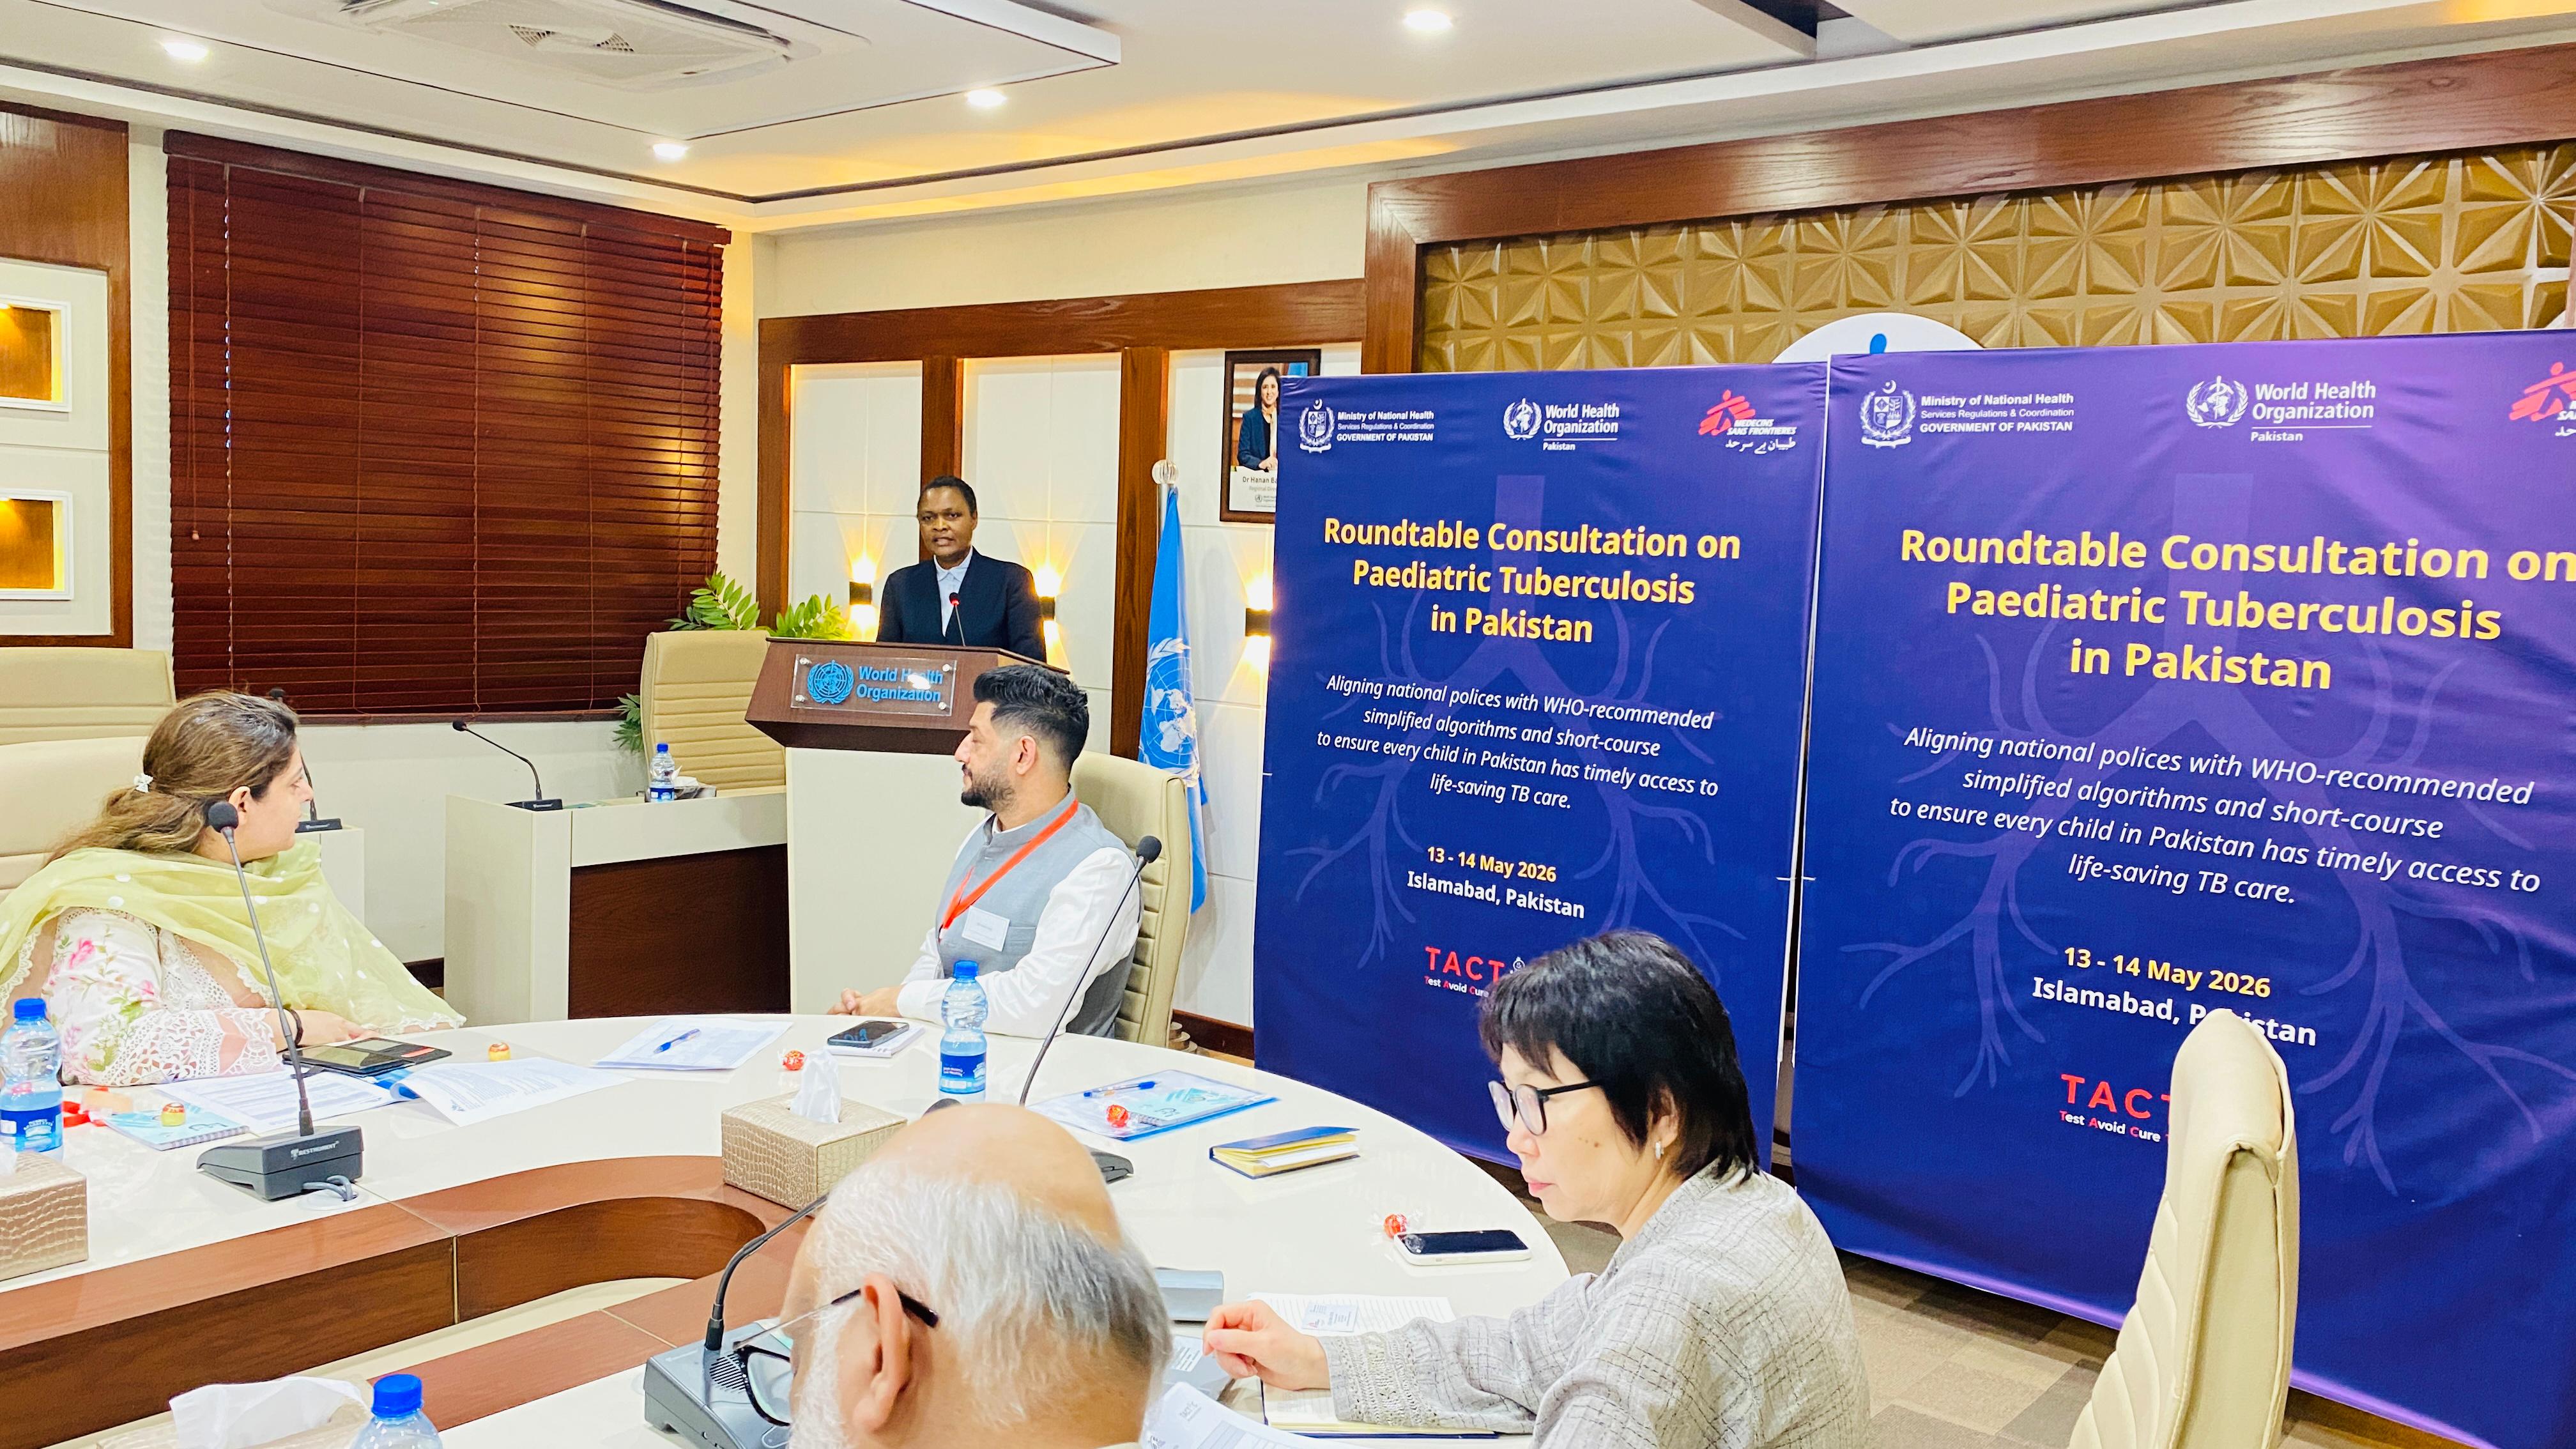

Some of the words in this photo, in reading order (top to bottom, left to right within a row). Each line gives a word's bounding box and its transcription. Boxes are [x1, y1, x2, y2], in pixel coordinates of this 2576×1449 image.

[1920, 395, 1966, 408] Ministry
[1968, 394, 1982, 406] of
[1984, 394, 2032, 405] National
[2035, 393, 2074, 404] Health
[2255, 381, 2308, 401] World
[2314, 380, 2376, 399] Health
[1337, 411, 1367, 422] Ministry
[1368, 411, 1377, 420] of
[1377, 411, 1408, 420] National
[1409, 410, 1434, 420] Health
[1361, 423, 1393, 431] Regulations
[1543, 418, 1619, 437] Organization
[1545, 403, 1579, 418] World
[1581, 402, 1620, 418] Health
[1919, 422, 1997, 433] GOVERNMENT
[1998, 422, 2015, 432] OF
[2016, 421, 2073, 432] PAKISTAN
[1920, 410, 1956, 419] Services
[1958, 409, 2008, 420] Regulations
[2009, 408, 2017, 417] &
[2018, 408, 2074, 417] Coordination
[2252, 401, 2374, 424] Organization
[2557, 410, 2576, 421] SA
[1336, 433, 1385, 441] GOVERNMENT
[1386, 433, 1397, 441] OF
[1397, 433, 1434, 441] PAKISTAN
[1542, 441, 1576, 450] Pakistan
[1726, 427, 1748, 435] SANS
[2250, 431, 2303, 441] Pakistan
[1324, 518, 1480, 549] Roundtable
[1487, 523, 1687, 557] Consultation
[1697, 535, 1740, 559] on
[1901, 529, 2147, 568] Roundtable
[2161, 535, 2488, 579] Consultation
[2507, 551, 2576, 582] on
[1353, 559, 1492, 593] Paediatric
[1499, 566, 1695, 604] Tuberculosis
[1431, 604, 1456, 633] in
[1465, 607, 1593, 643] Pakistan
[1947, 581, 2166, 624] Paediatric
[2179, 590, 2502, 640] Tuberculosis
[859, 666, 898, 682] World
[901, 668, 944, 684] Hlth
[2071, 638, 2110, 675] in
[2125, 643, 2331, 689] Pakistan
[856, 683, 941, 703] Organization
[1326, 675, 1384, 700] Aligning
[1386, 682, 1448, 702] national
[1448, 687, 1502, 708] polices
[1505, 693, 1538, 712] with
[1544, 696, 1715, 730] WHO-recommended
[1363, 707, 1434, 732] simplified
[1436, 715, 1518, 740] algorithms
[1521, 726, 1554, 744] and
[1555, 728, 1660, 756] short-course
[1317, 731, 1331, 746] to
[1334, 735, 1380, 753] ensure
[1383, 742, 1422, 762] every
[1423, 743, 1460, 763] child
[1462, 747, 1476, 765] in
[1480, 750, 1547, 774] Pakistan
[1550, 758, 1580, 778] has
[1584, 763, 1636, 790] timely
[1639, 774, 1696, 793] access
[1699, 779, 1719, 796] to
[1903, 727, 1994, 758] Aligning
[1999, 738, 2096, 763] national
[2098, 746, 2182, 771] polices
[2189, 753, 2242, 777] with
[2252, 757, 2535, 804] WHO-recommended
[1430, 772, 1506, 804] life-saving
[1511, 784, 1530, 802] TB
[1533, 791, 1570, 809] care.
[1962, 769, 2073, 800] simplified
[2077, 780, 2208, 813] algorithms
[2214, 797, 2267, 819] and
[2270, 800, 2444, 838] short-course
[1890, 798, 1912, 816] to
[1917, 804, 1988, 826] ensure
[1994, 813, 2054, 839] every
[2058, 816, 2115, 841] child
[2119, 822, 2142, 845] in
[2149, 826, 2255, 858] Pakistan
[2262, 838, 2310, 864] has
[2317, 846, 2403, 881] timely
[2408, 861, 2503, 887] access
[2510, 870, 2540, 892] to
[1427, 846, 1445, 863] 13
[1458, 851, 1476, 868] 14
[1480, 854, 1515, 879] May
[1517, 861, 1557, 882] 2026
[2068, 854, 2189, 894] life-saving
[2198, 870, 2228, 894] TB
[2234, 880, 2295, 903] care.
[1407, 870, 1501, 906] Islamabad,
[1506, 888, 1584, 919] Pakistan
[1425, 946, 1505, 985] TACT
[2064, 947, 2091, 968] 13
[2113, 954, 2141, 977] 14
[2148, 960, 2203, 992] May
[2208, 970, 2271, 998] 2026
[1424, 976, 1441, 988] Test
[1443, 980, 1468, 993] Avoid
[1469, 986, 1489, 998] Cure
[2032, 976, 2180, 1025] Islamabad,
[2059, 1110, 2085, 1126] Test
[2088, 1117, 2126, 1135] Avoid
[2129, 1126, 2161, 1142] Cure
